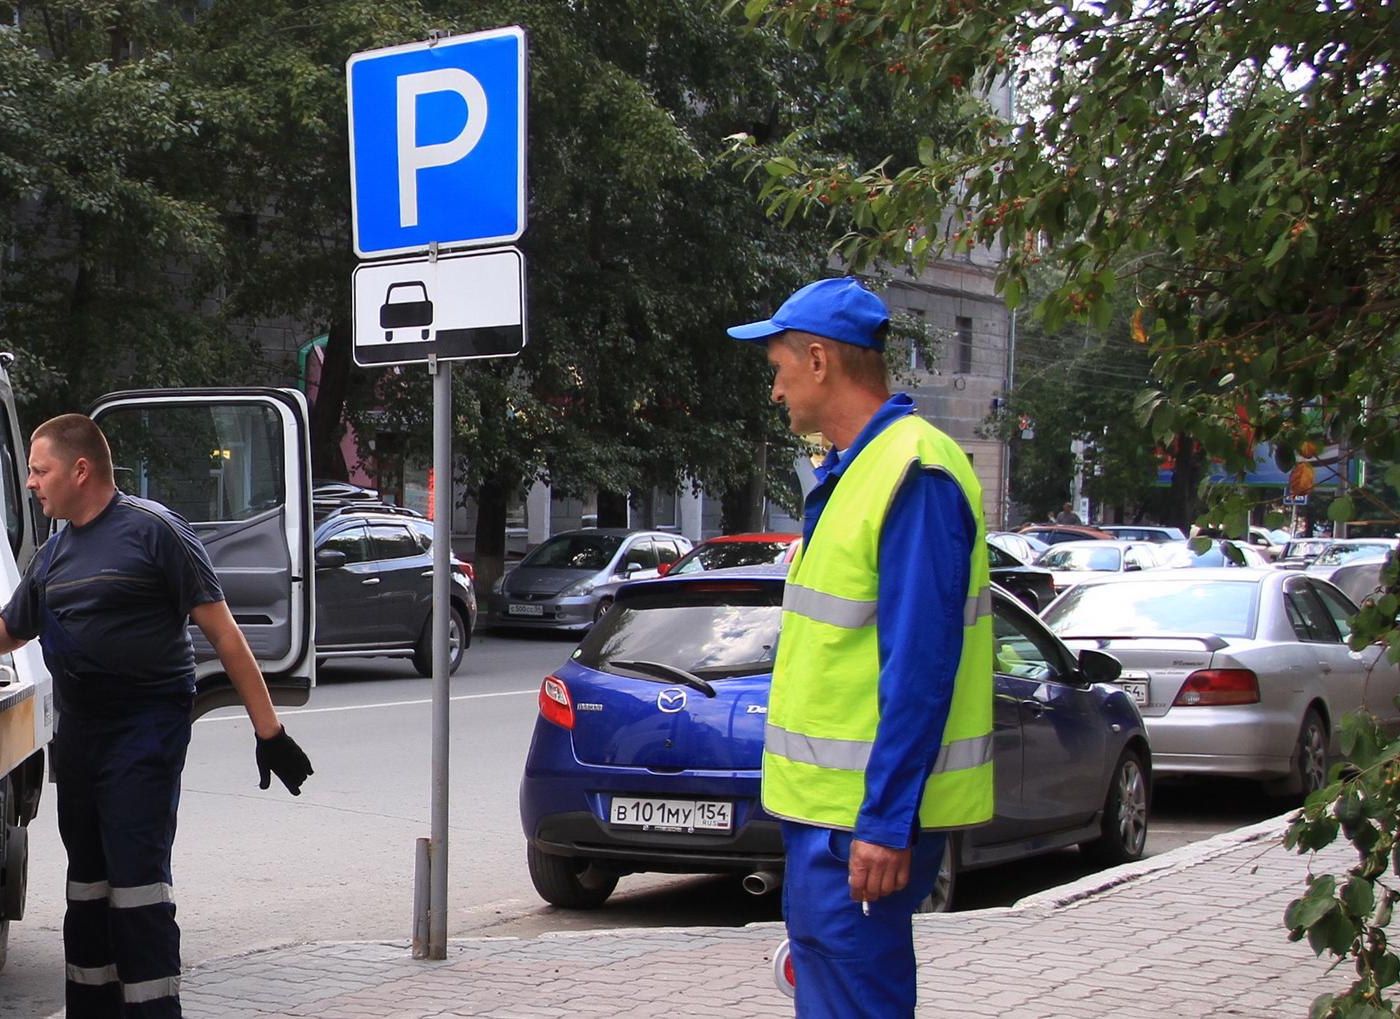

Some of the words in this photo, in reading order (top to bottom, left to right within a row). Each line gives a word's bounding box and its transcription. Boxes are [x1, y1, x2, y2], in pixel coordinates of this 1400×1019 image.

[397, 68, 488, 229] P
[617, 801, 692, 824] В101МУ
[697, 803, 726, 821] 154
